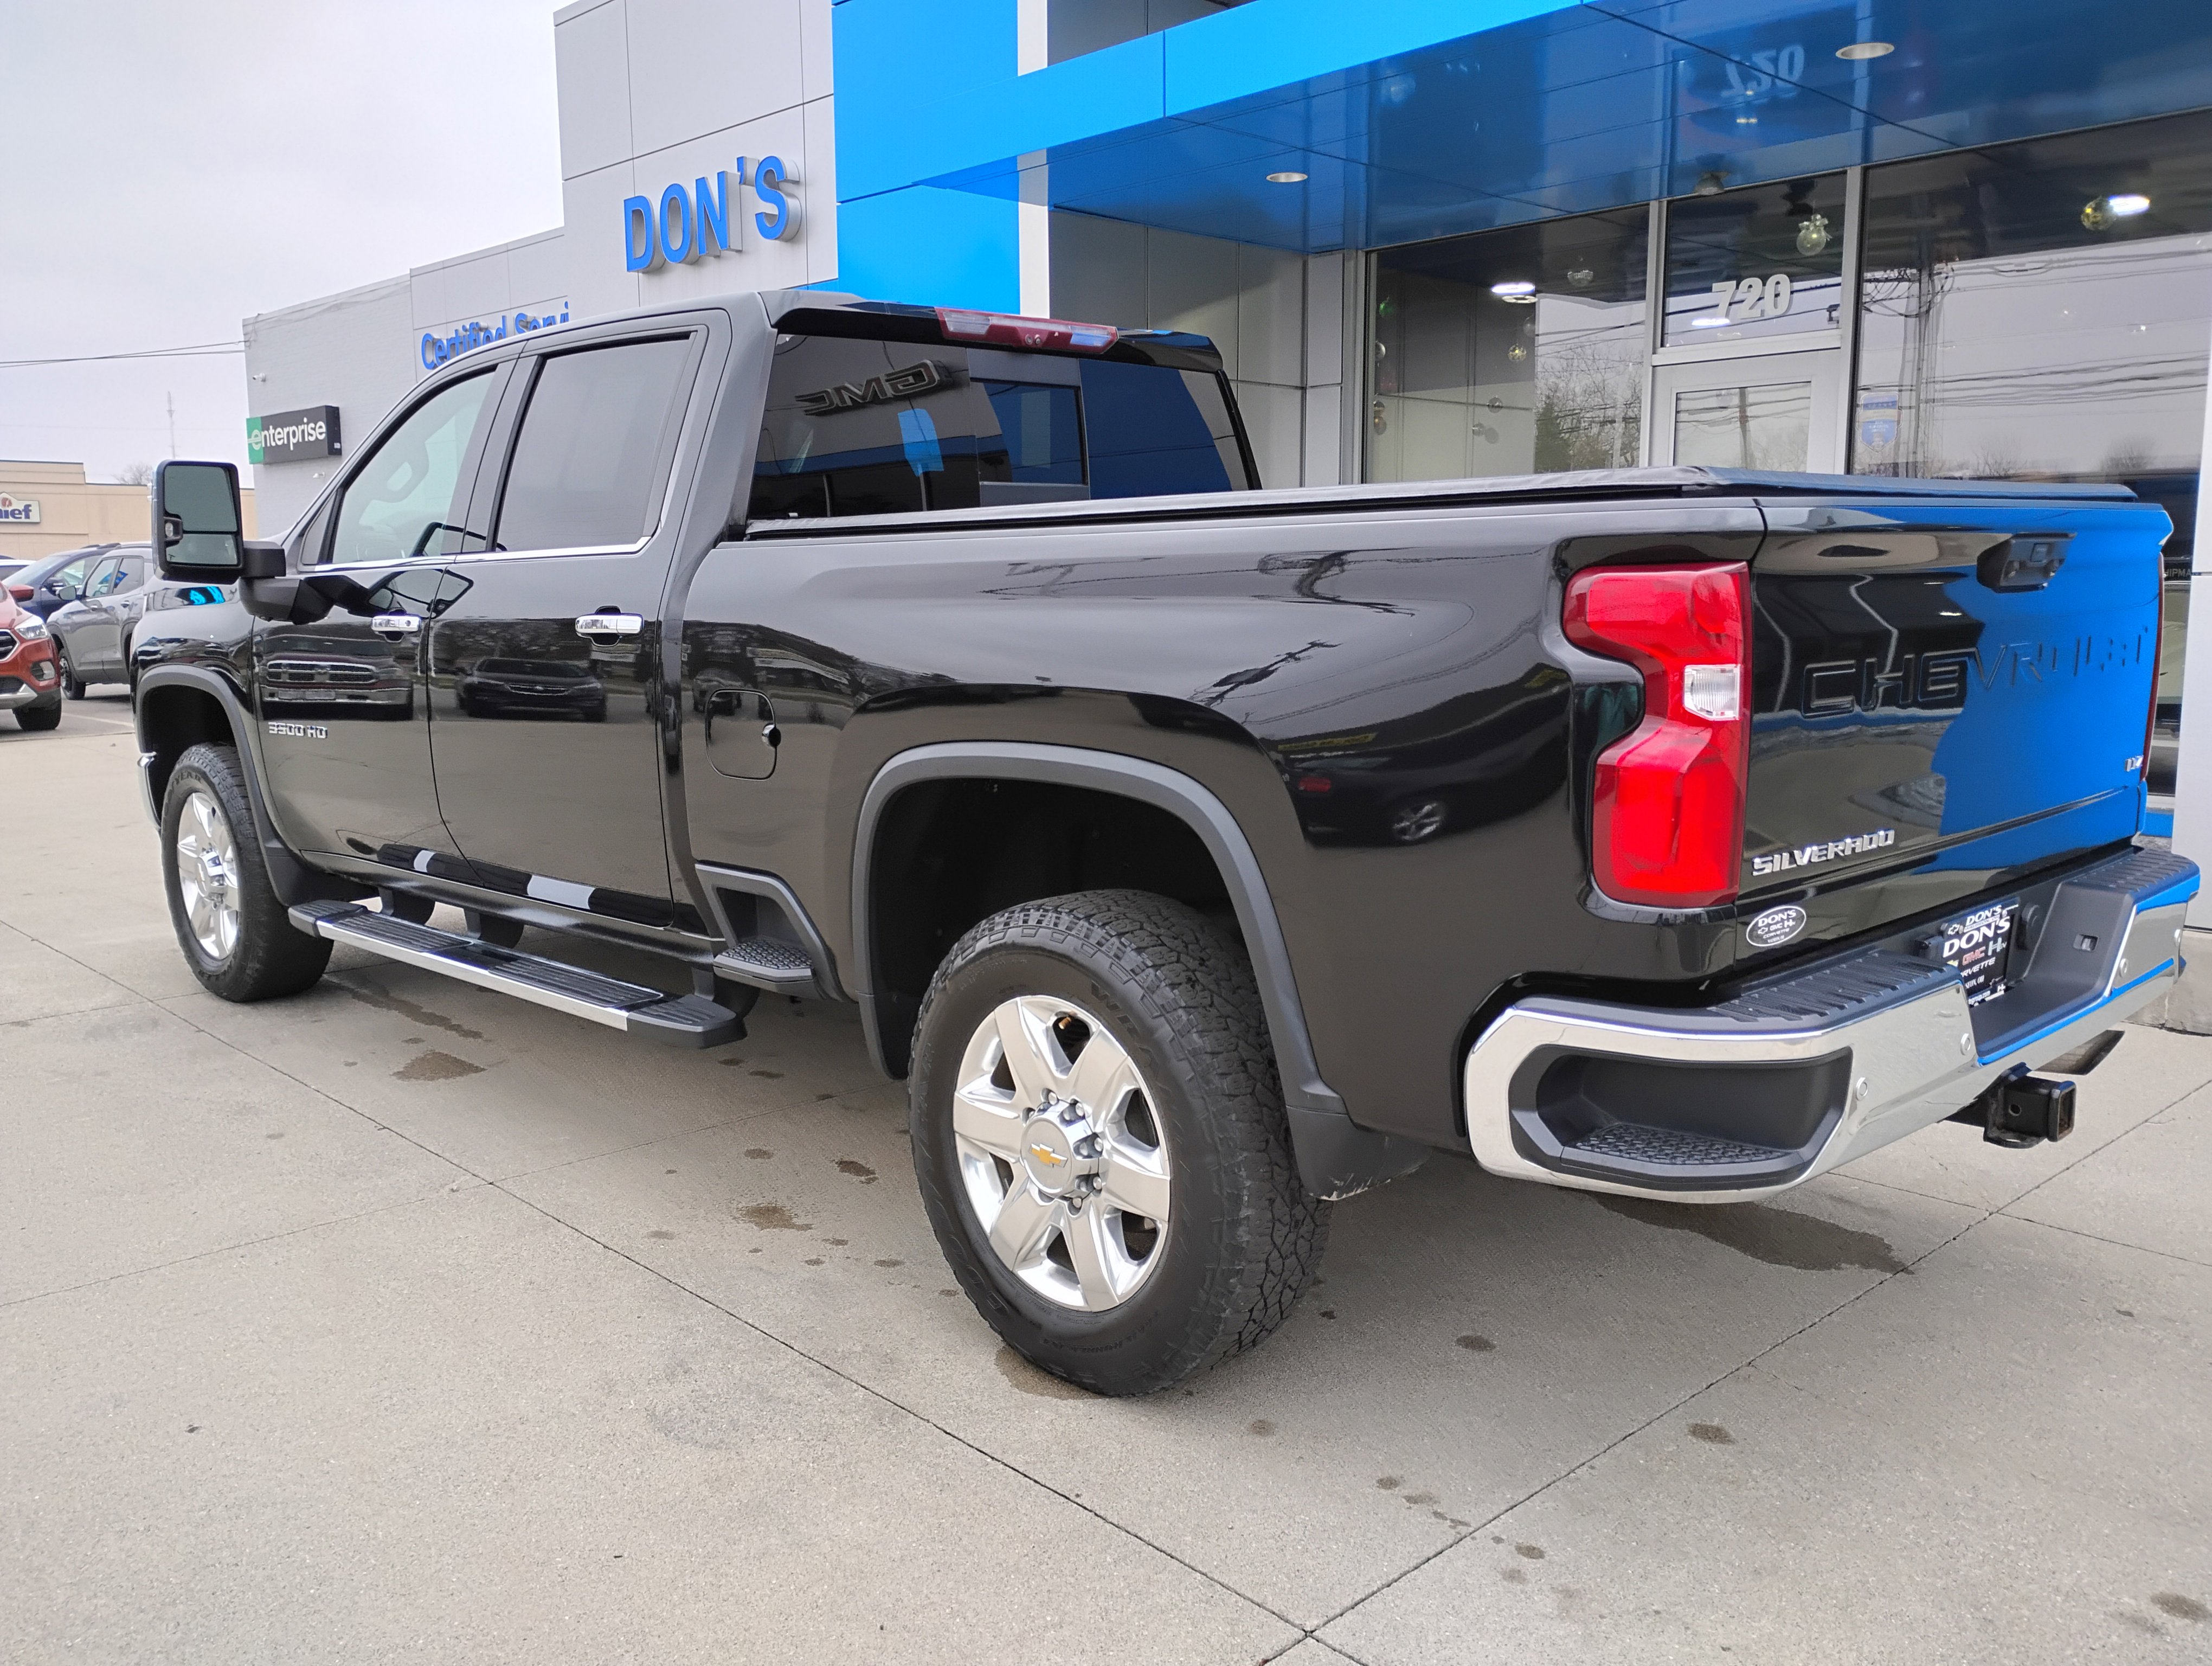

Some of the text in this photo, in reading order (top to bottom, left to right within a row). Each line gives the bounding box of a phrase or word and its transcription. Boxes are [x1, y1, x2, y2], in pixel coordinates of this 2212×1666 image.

[623, 155, 792, 272] DON'S
[1712, 273, 1791, 320] 720
[248, 417, 326, 451] enterprise
[268, 722, 328, 739] 3500 HD
[1752, 829, 1895, 877] SILVERADO
[1758, 909, 1797, 927] DON'S
[1965, 905, 2002, 926] DON'S
[1943, 915, 2011, 958] DON'S
[1960, 956, 1996, 978] RVETTE
[1962, 946, 1986, 966] GMC
